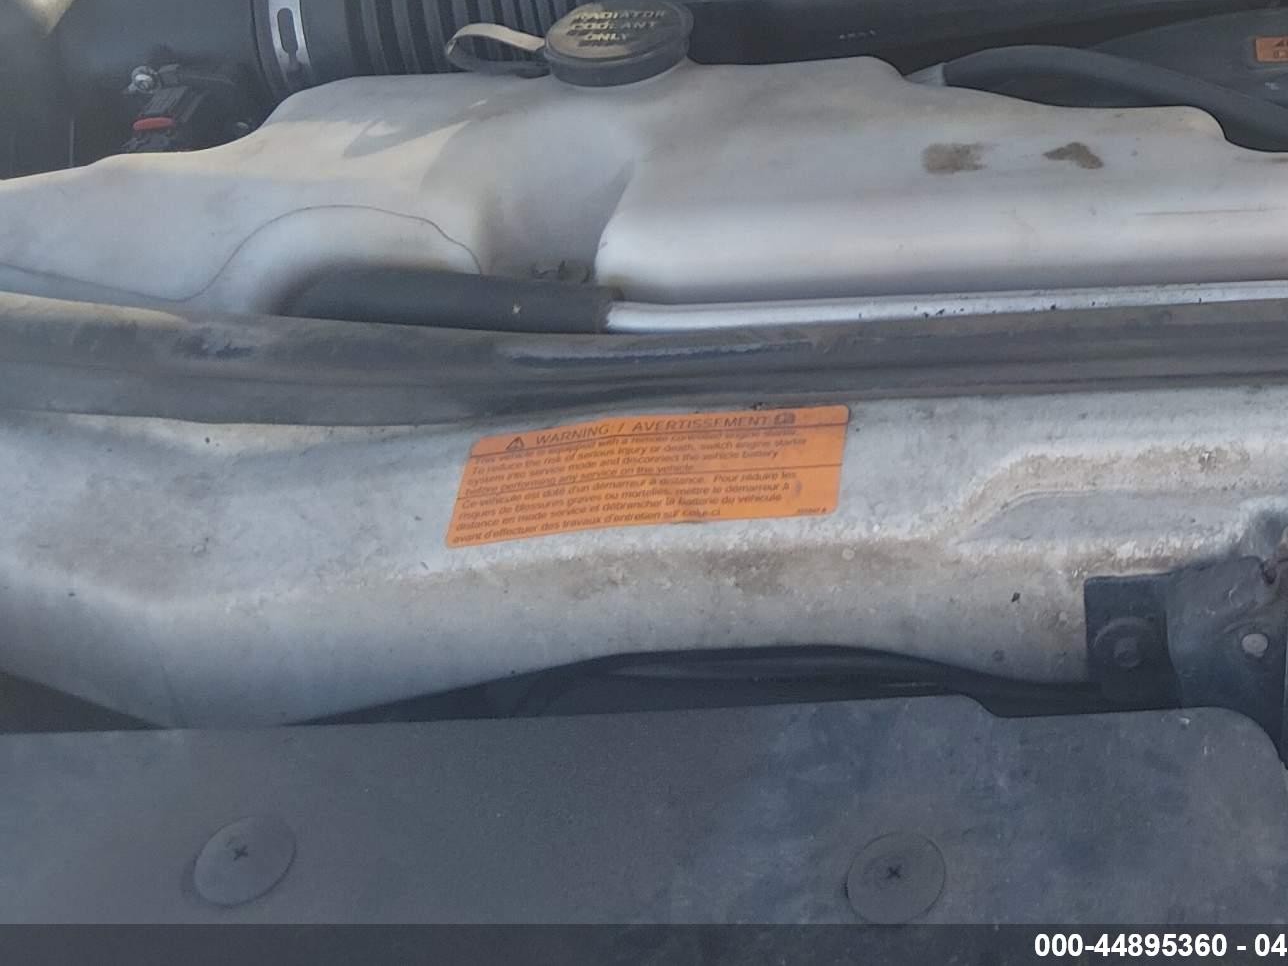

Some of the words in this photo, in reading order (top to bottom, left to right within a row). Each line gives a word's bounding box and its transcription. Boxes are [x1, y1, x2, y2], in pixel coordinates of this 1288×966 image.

[574, 9, 665, 19] RADIATOR
[571, 21, 656, 30] COOLANT
[585, 33, 627, 41] ONLY
[536, 424, 609, 444] WARNING
[632, 416, 768, 433] AVERTISSEMENT
